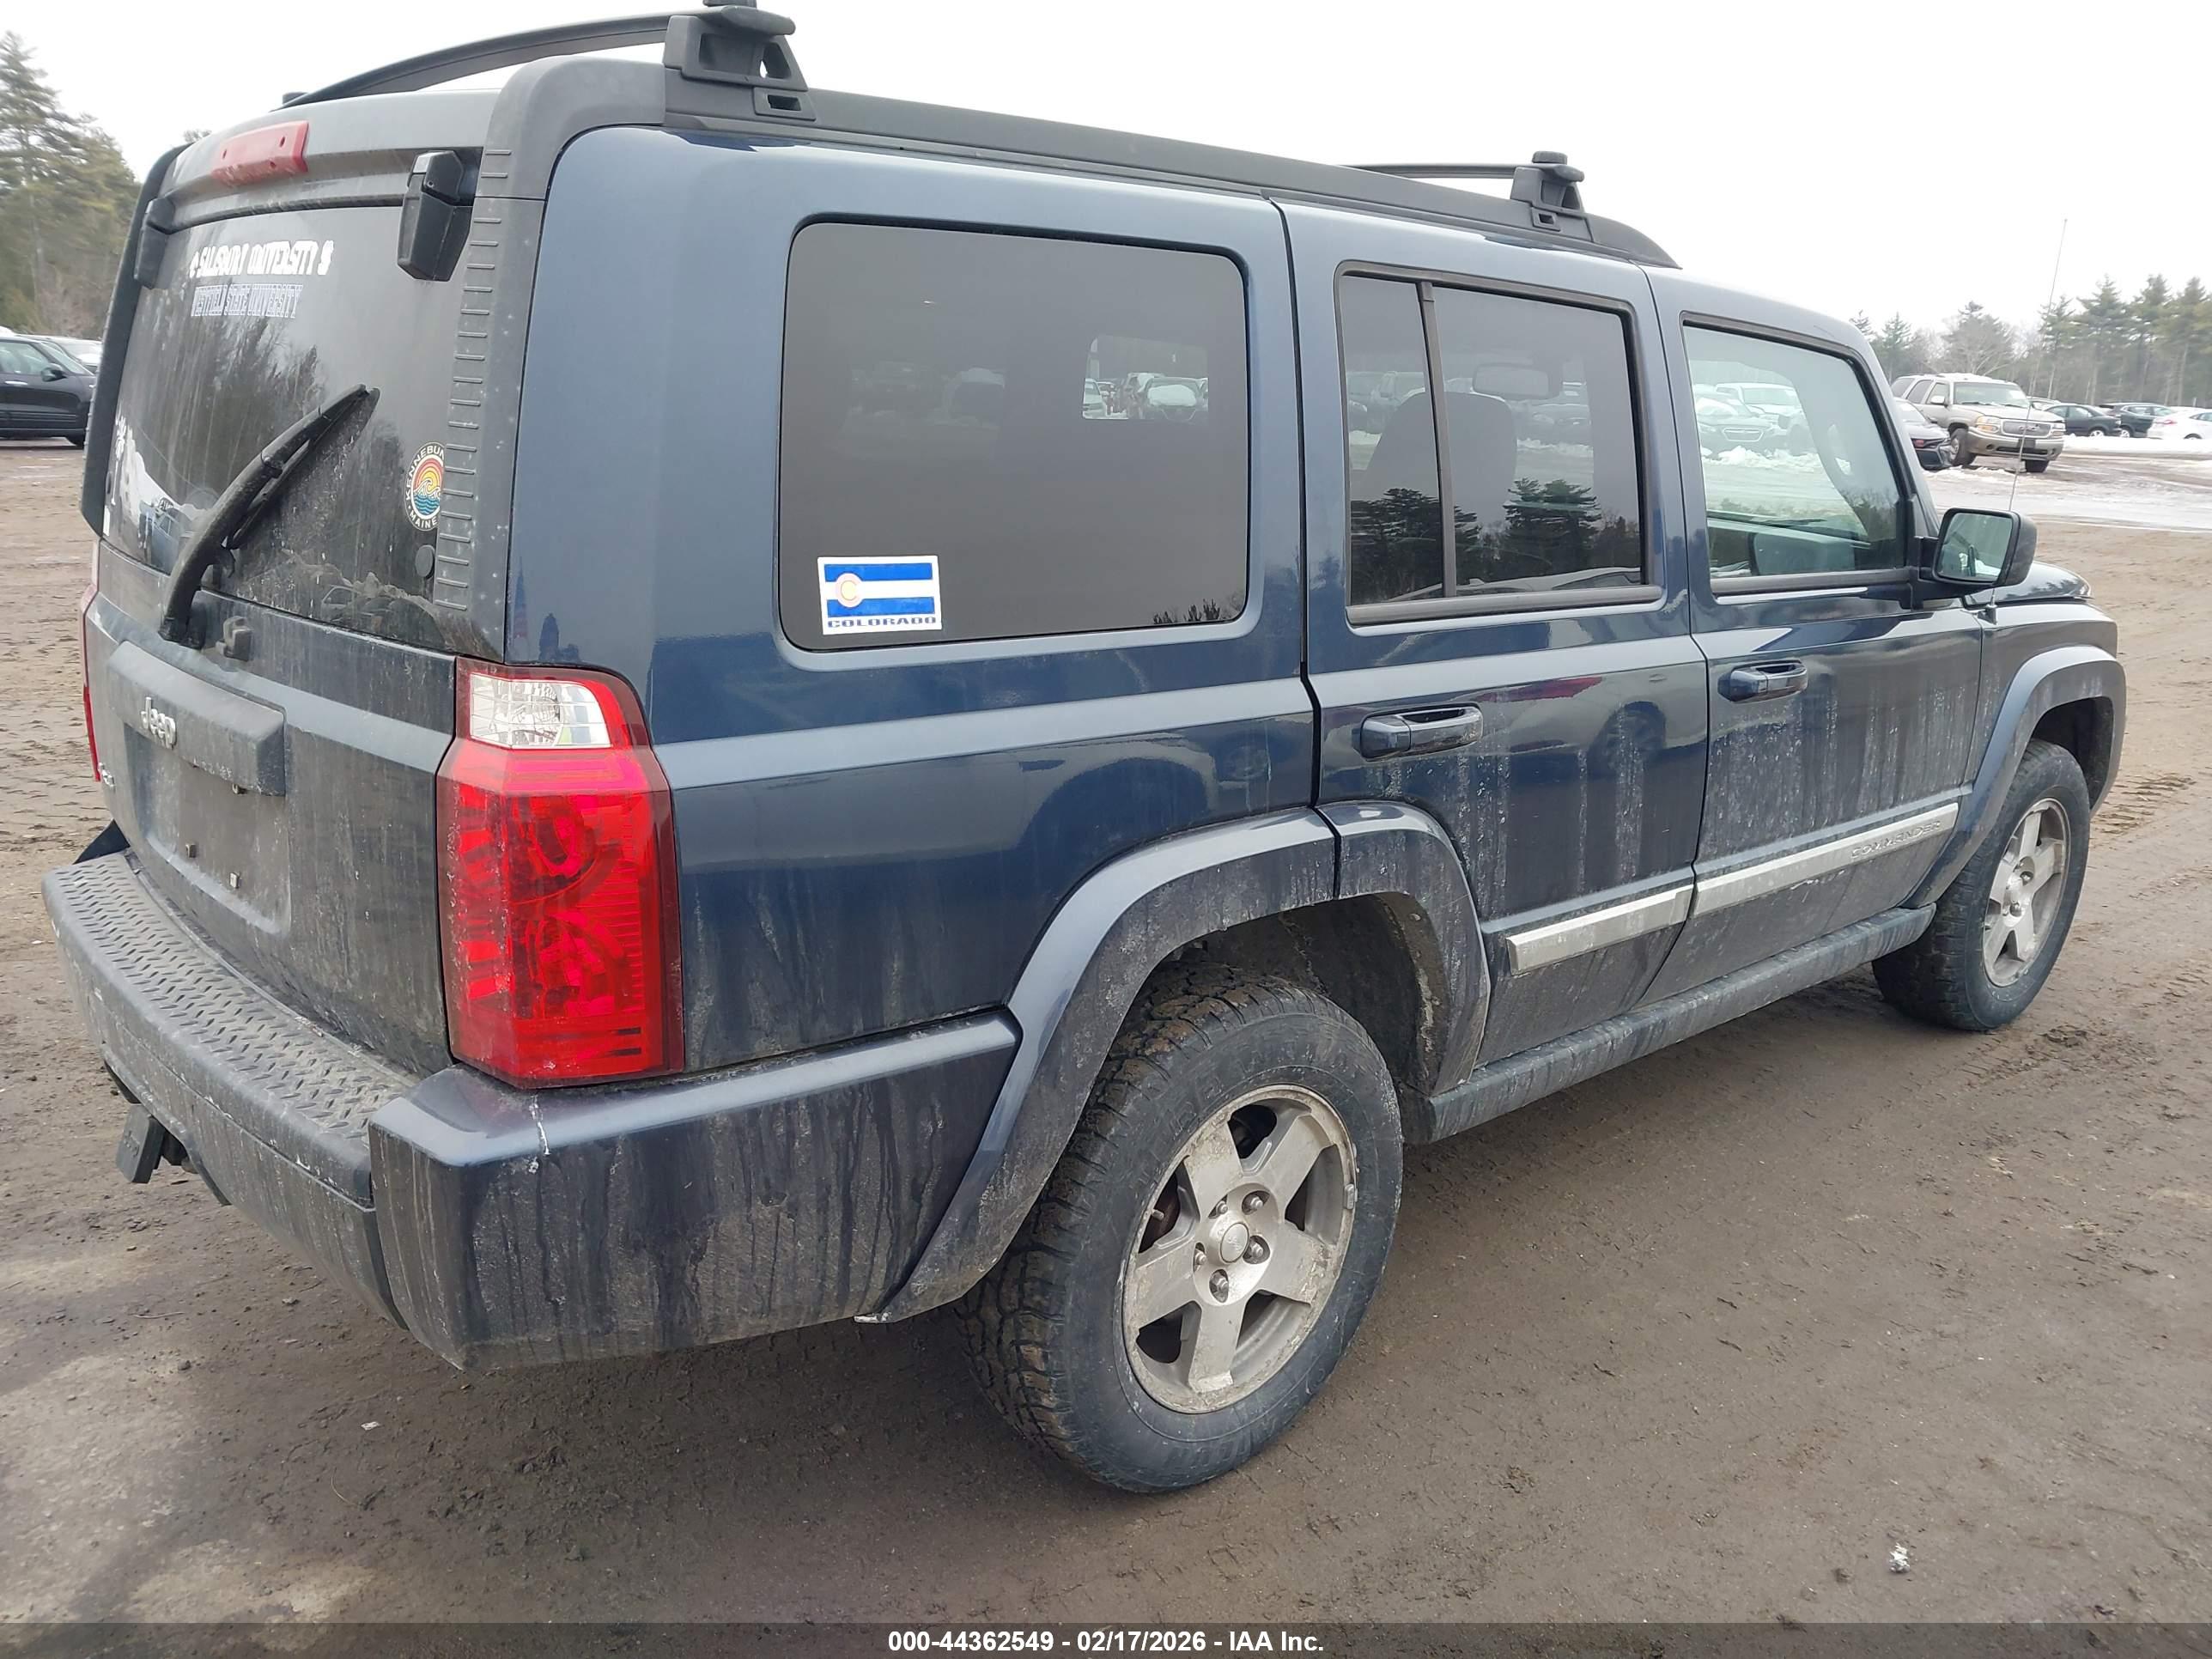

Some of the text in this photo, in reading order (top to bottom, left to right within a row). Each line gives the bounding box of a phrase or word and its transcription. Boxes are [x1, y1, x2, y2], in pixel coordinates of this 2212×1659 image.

[246, 240, 319, 276] UNIVERSITY
[246, 283, 303, 319] UNIVERSITY
[409, 510, 438, 529] MAINE
[827, 616, 937, 629] COLORADO
[140, 696, 176, 749] Jeep
[1850, 820, 1942, 859] COMMANDER
